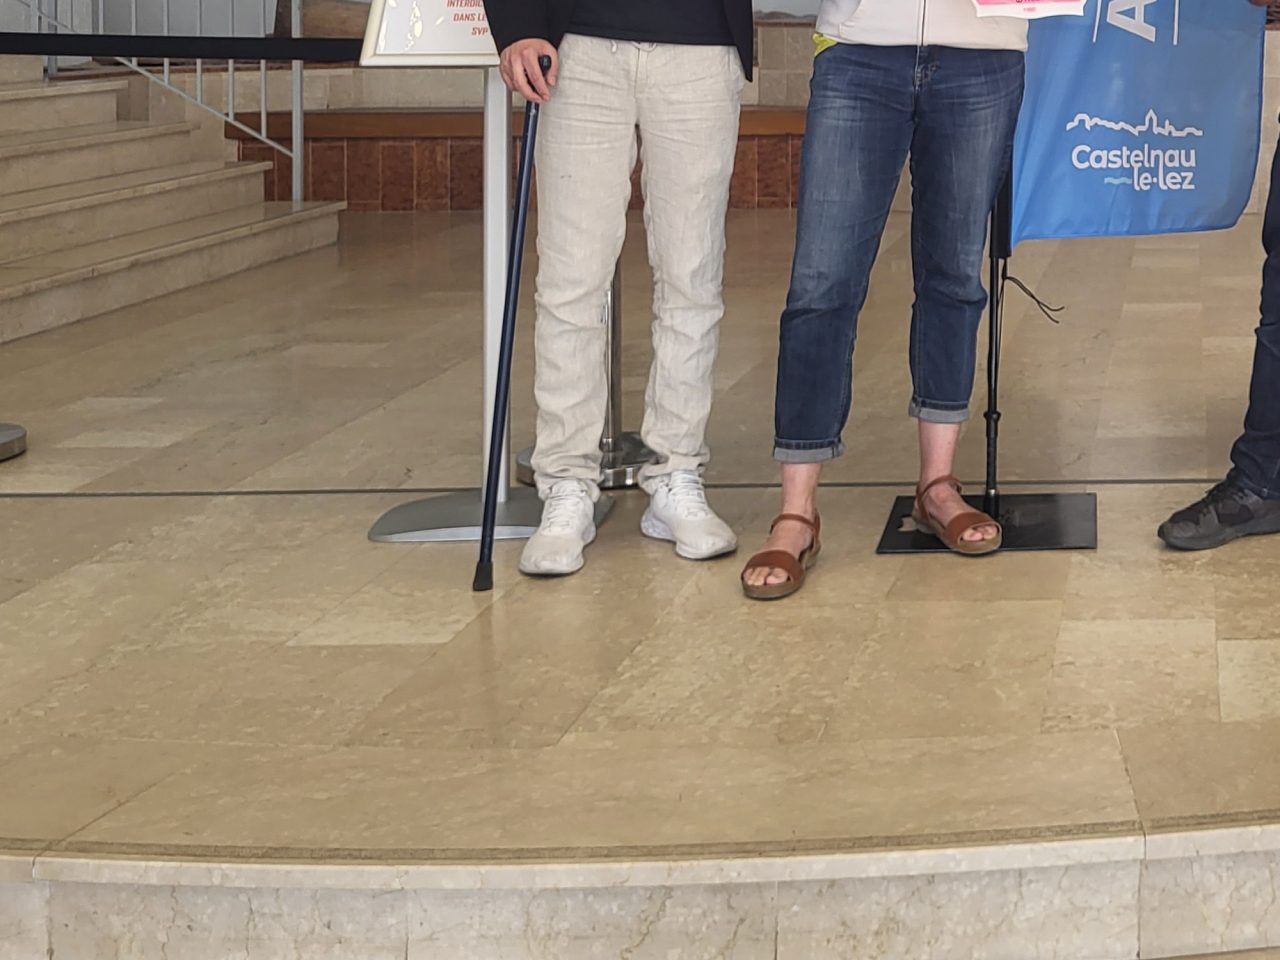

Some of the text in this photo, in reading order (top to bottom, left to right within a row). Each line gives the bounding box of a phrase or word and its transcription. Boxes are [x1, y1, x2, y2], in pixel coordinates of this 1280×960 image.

[447, 0, 484, 8] INTERDIC
[454, 12, 476, 22] DANS
[472, 26, 488, 36] SVP
[1071, 143, 1197, 170] Castelnau
